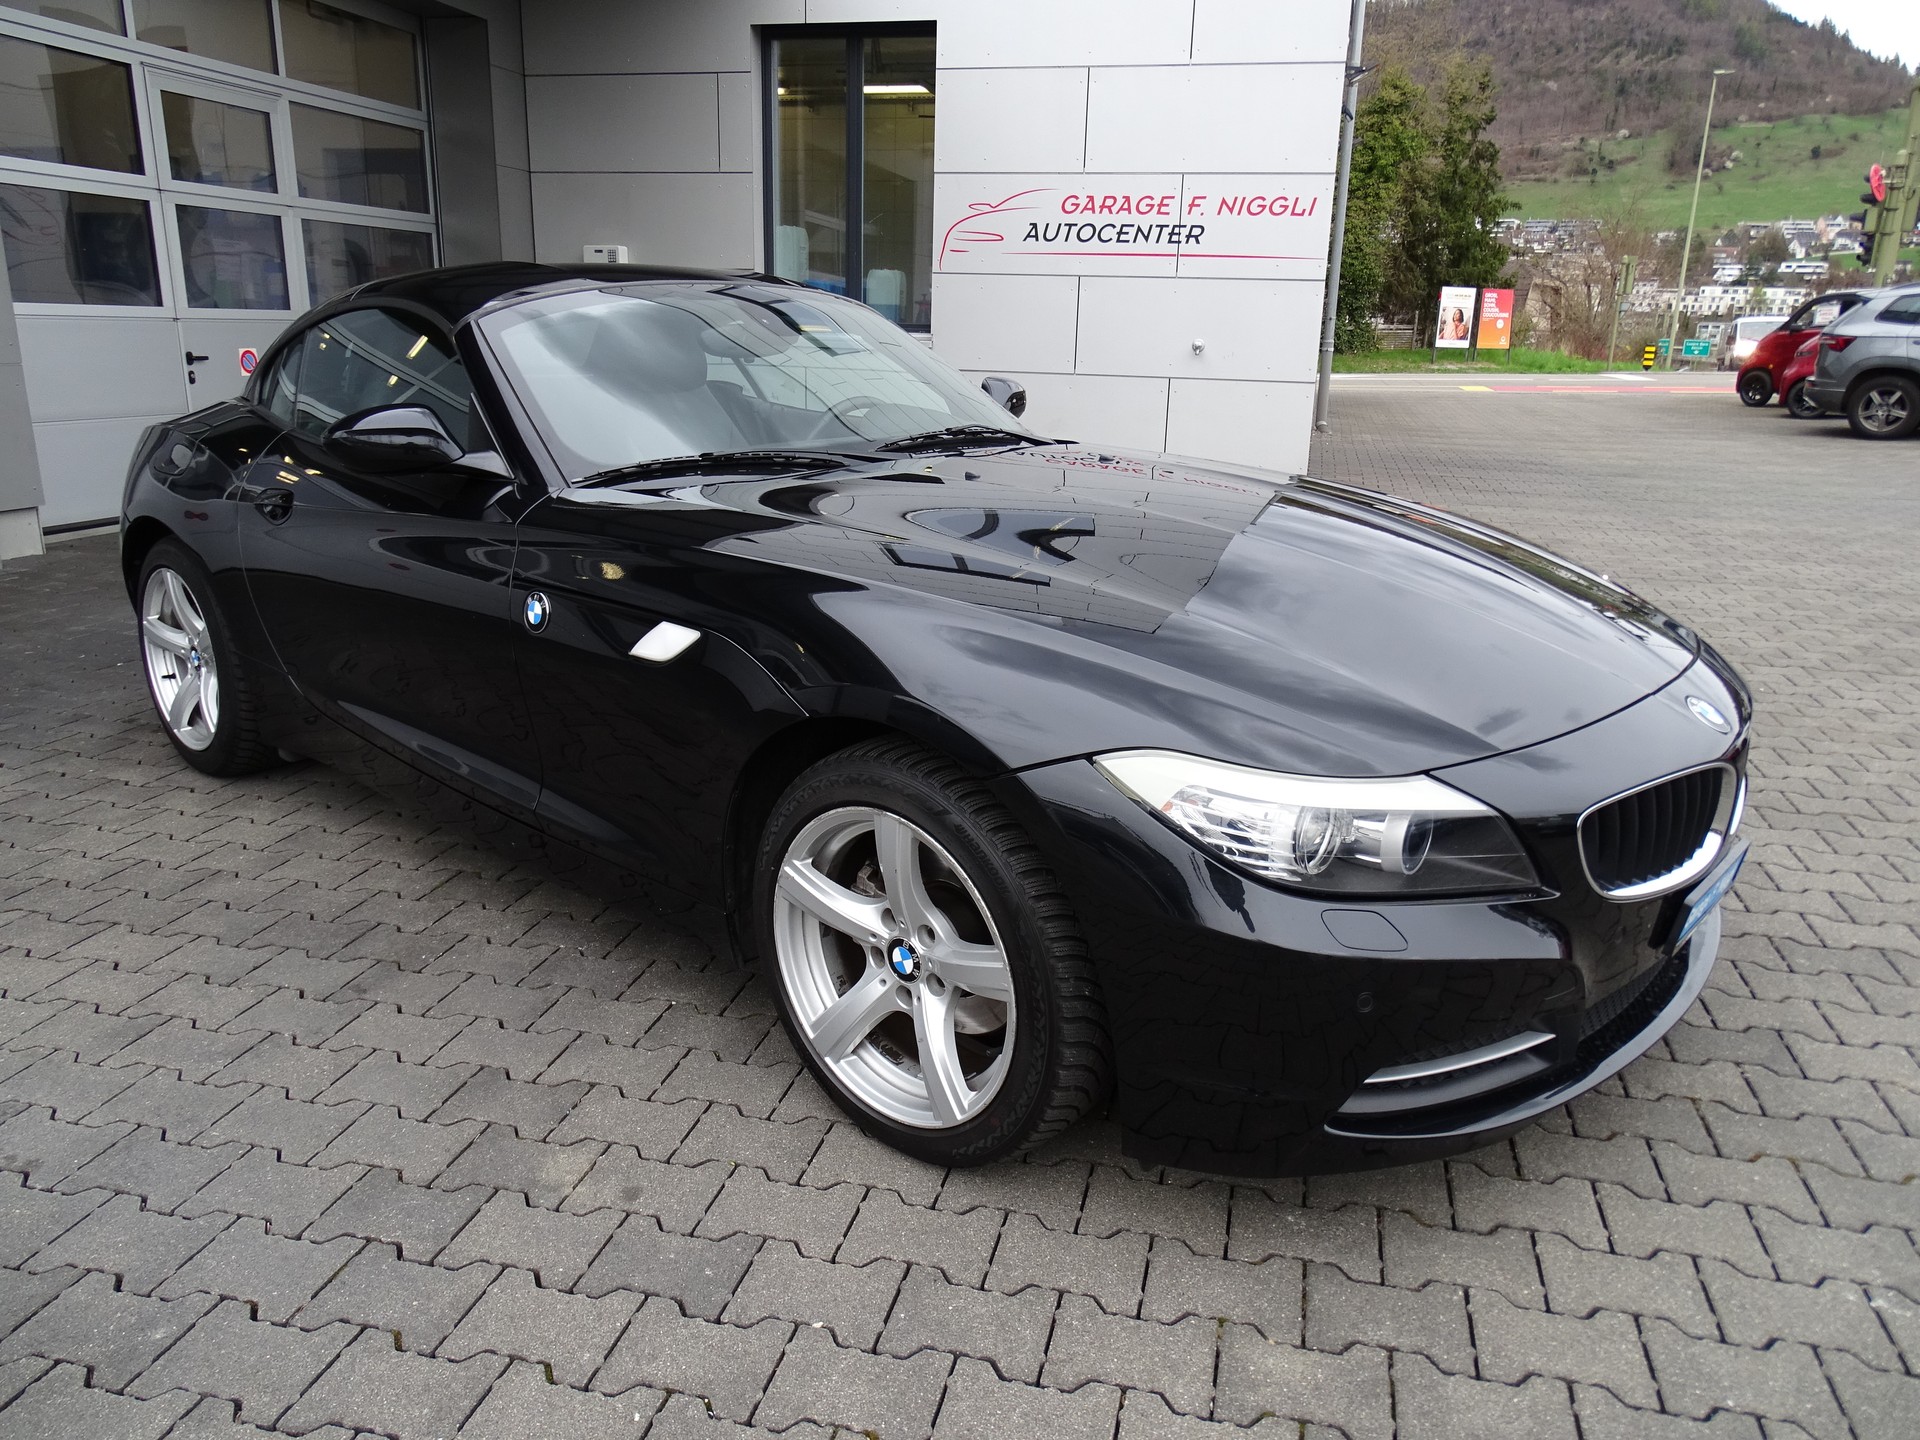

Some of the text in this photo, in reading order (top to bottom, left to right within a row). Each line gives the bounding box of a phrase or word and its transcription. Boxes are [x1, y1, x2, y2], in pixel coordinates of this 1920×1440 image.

[1061, 194, 1318, 217] GARAGE F. NIGGLI
[1022, 222, 1205, 244] AUTOCENTER
